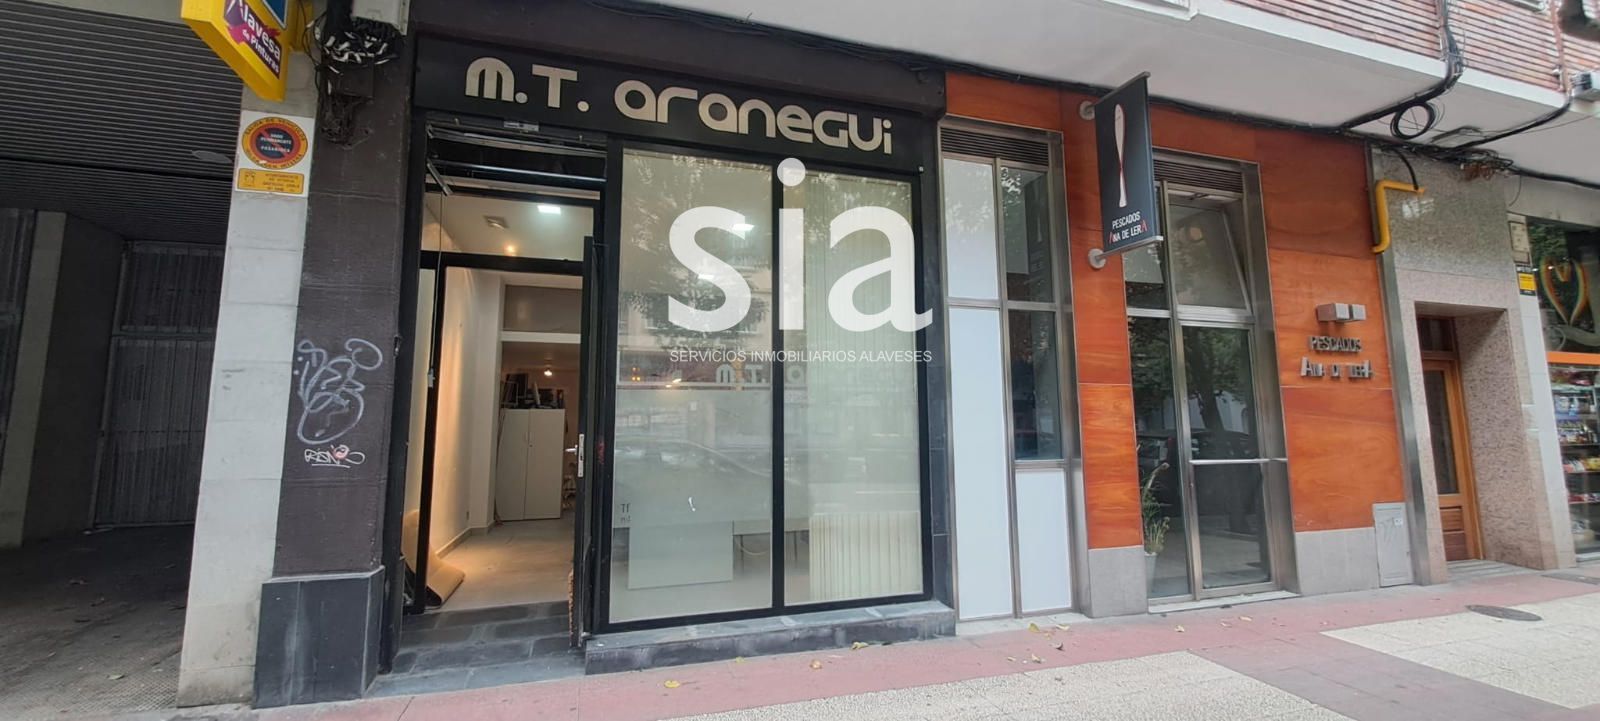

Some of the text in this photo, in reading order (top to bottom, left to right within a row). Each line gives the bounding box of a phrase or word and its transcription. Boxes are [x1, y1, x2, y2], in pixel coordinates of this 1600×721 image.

[250, 35, 280, 73] Pinturas
[1111, 211, 1141, 230] PESCADOS
[1121, 229, 1130, 239] DE
[1307, 335, 1362, 353] PESCADOS
